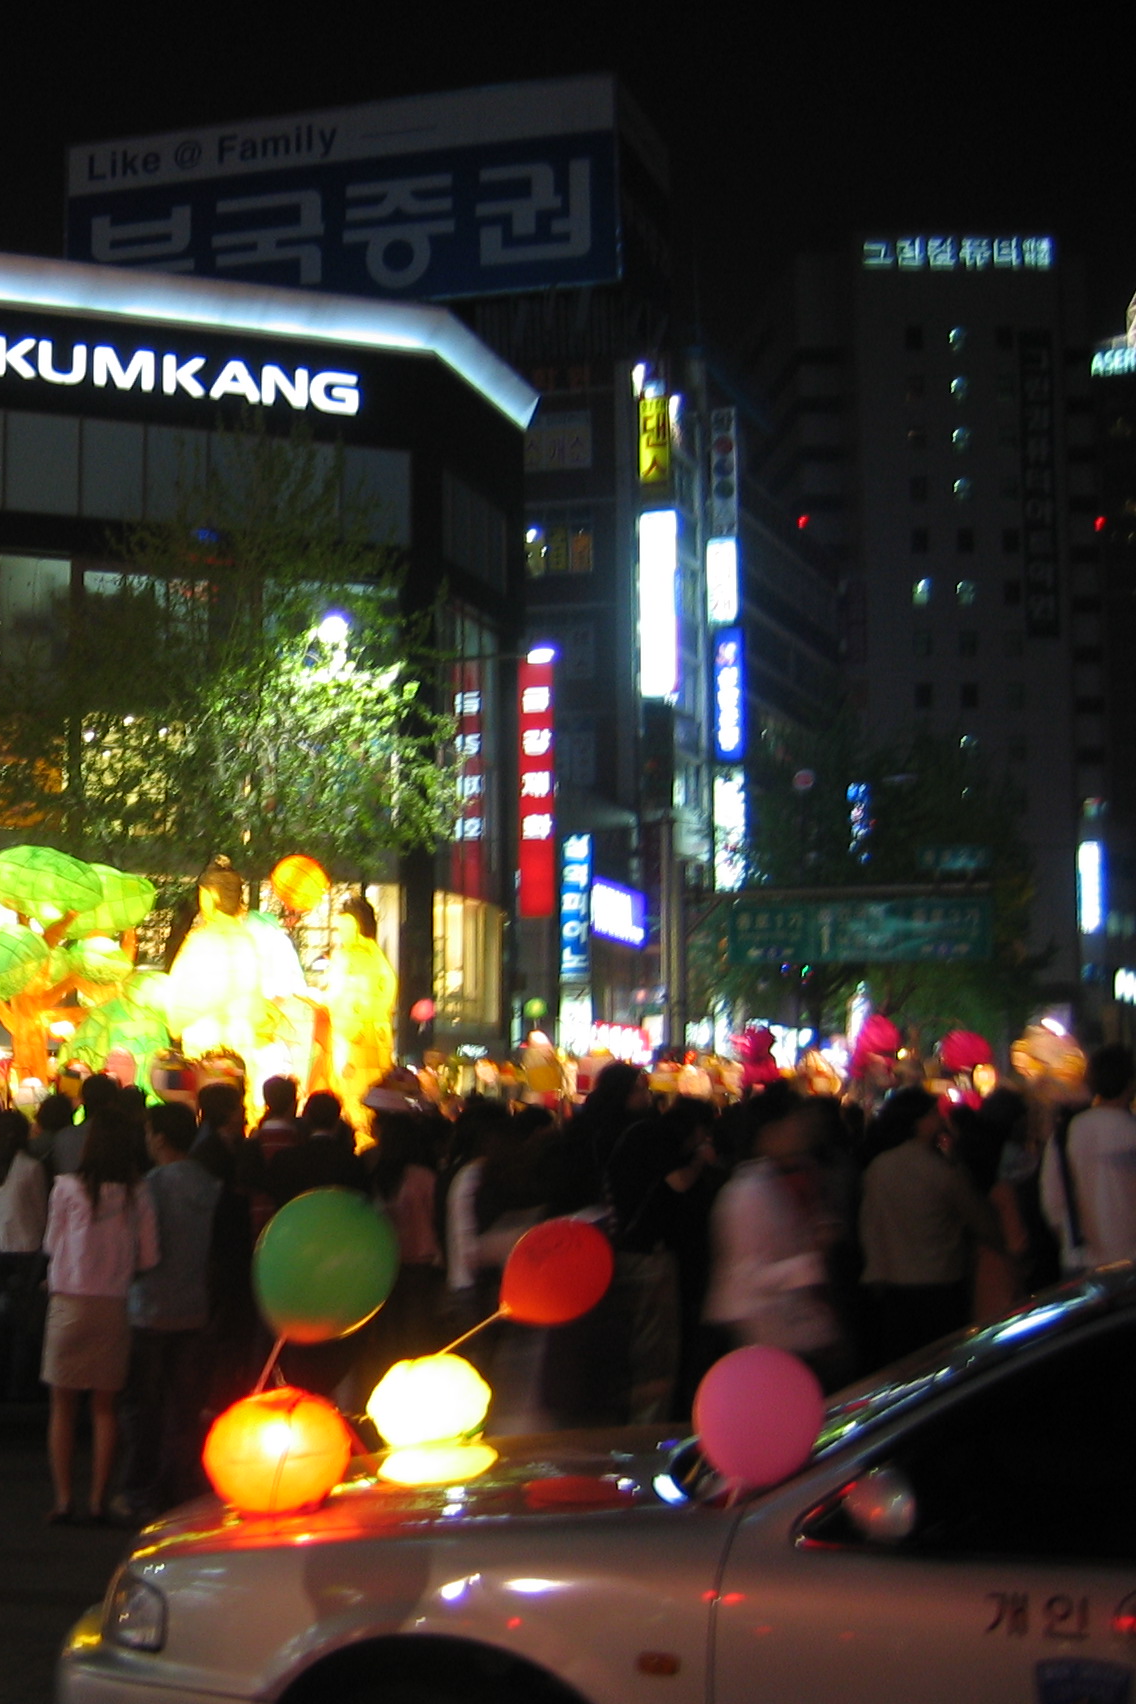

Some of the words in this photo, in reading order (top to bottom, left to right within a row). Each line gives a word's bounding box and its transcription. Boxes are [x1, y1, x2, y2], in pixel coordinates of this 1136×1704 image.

[87, 149, 162, 183] Like
[173, 139, 203, 170] @
[216, 123, 338, 166] Family
[90, 157, 591, 289] 부국증권
[984, 1590, 1091, 1641] 개인
